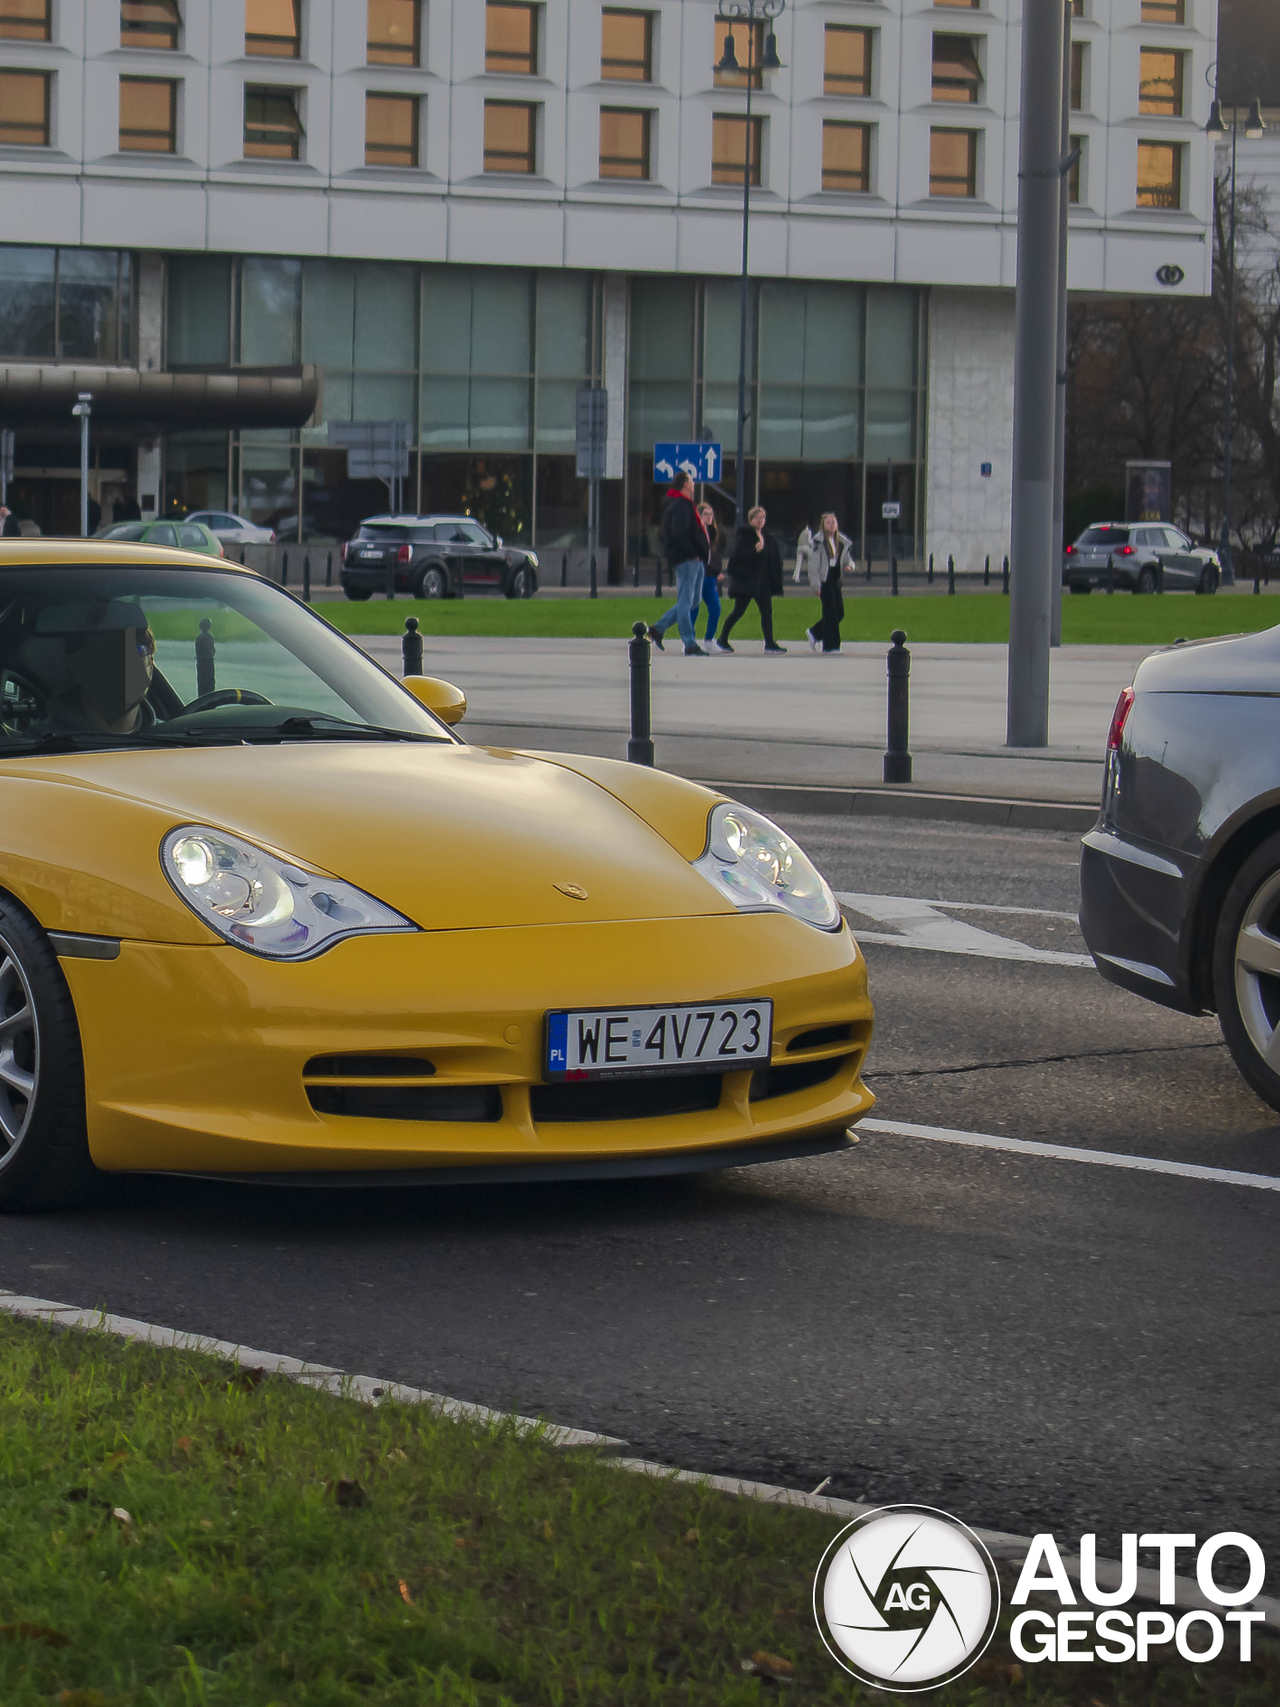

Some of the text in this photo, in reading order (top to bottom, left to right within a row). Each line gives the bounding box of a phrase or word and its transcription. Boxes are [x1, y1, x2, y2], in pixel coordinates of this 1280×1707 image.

[578, 1008, 762, 1064] WE 4V723
[550, 1049, 565, 1062] PL
